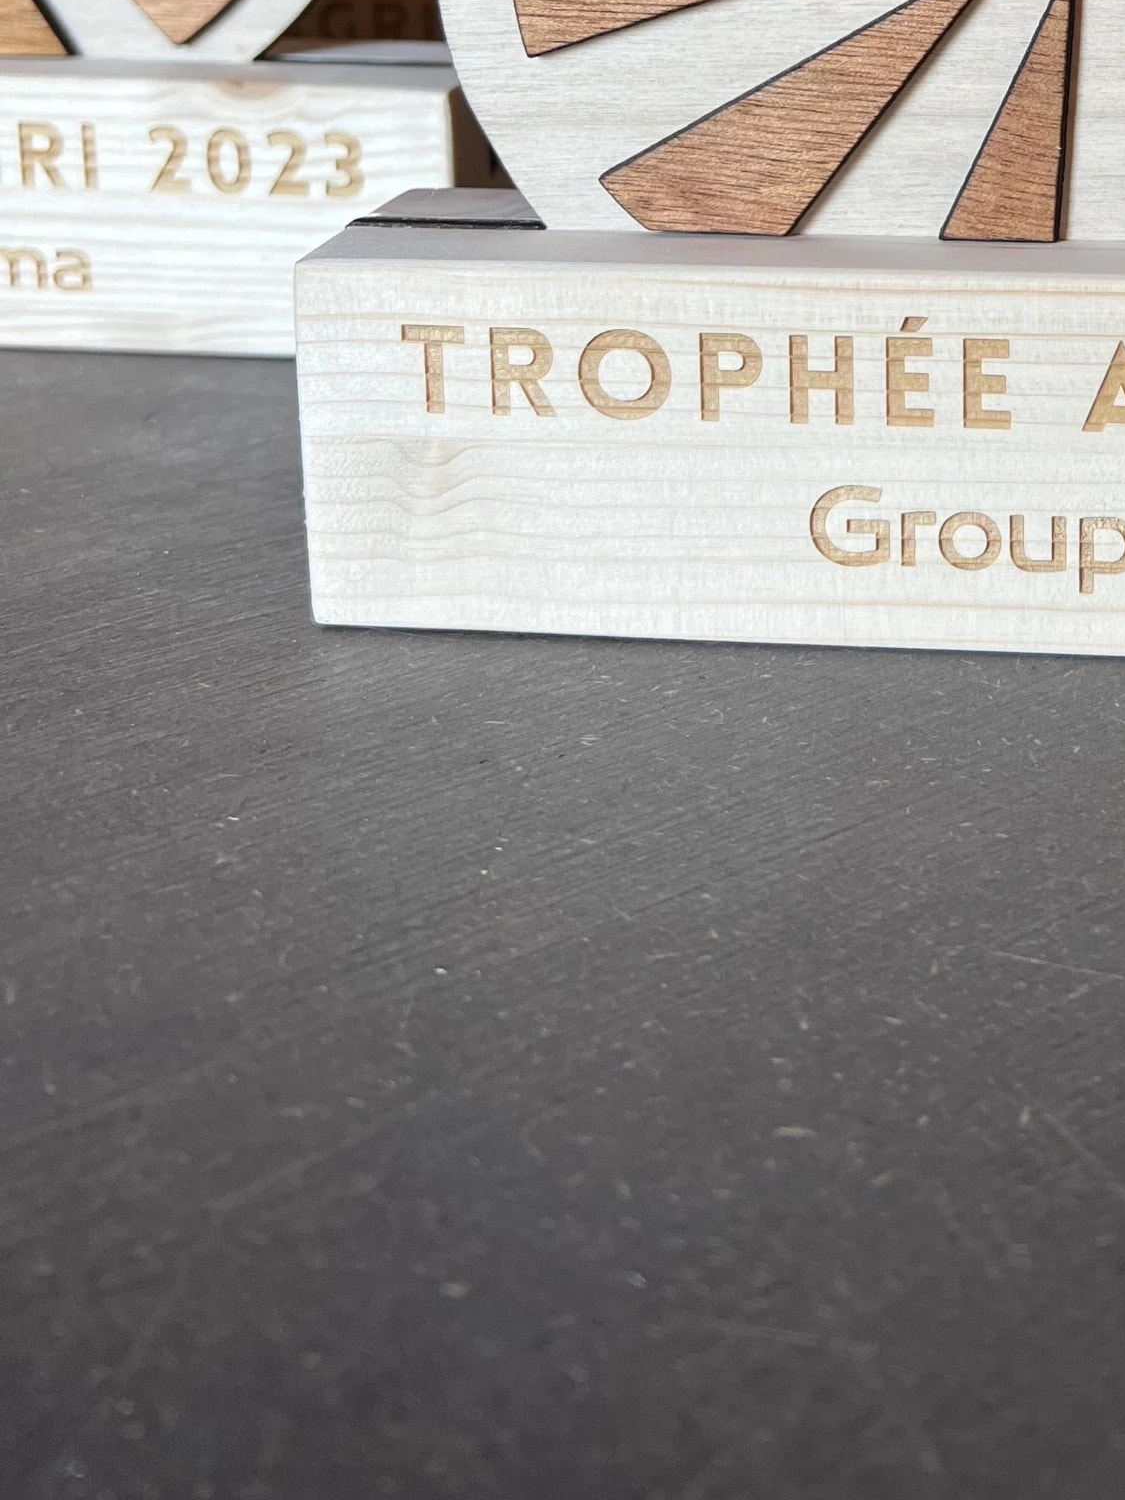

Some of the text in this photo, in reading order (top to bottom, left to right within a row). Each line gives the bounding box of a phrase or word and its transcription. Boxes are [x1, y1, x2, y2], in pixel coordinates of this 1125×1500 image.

[0, 122, 365, 197] RI 2023
[401, 316, 1012, 430] TROPHÉE
